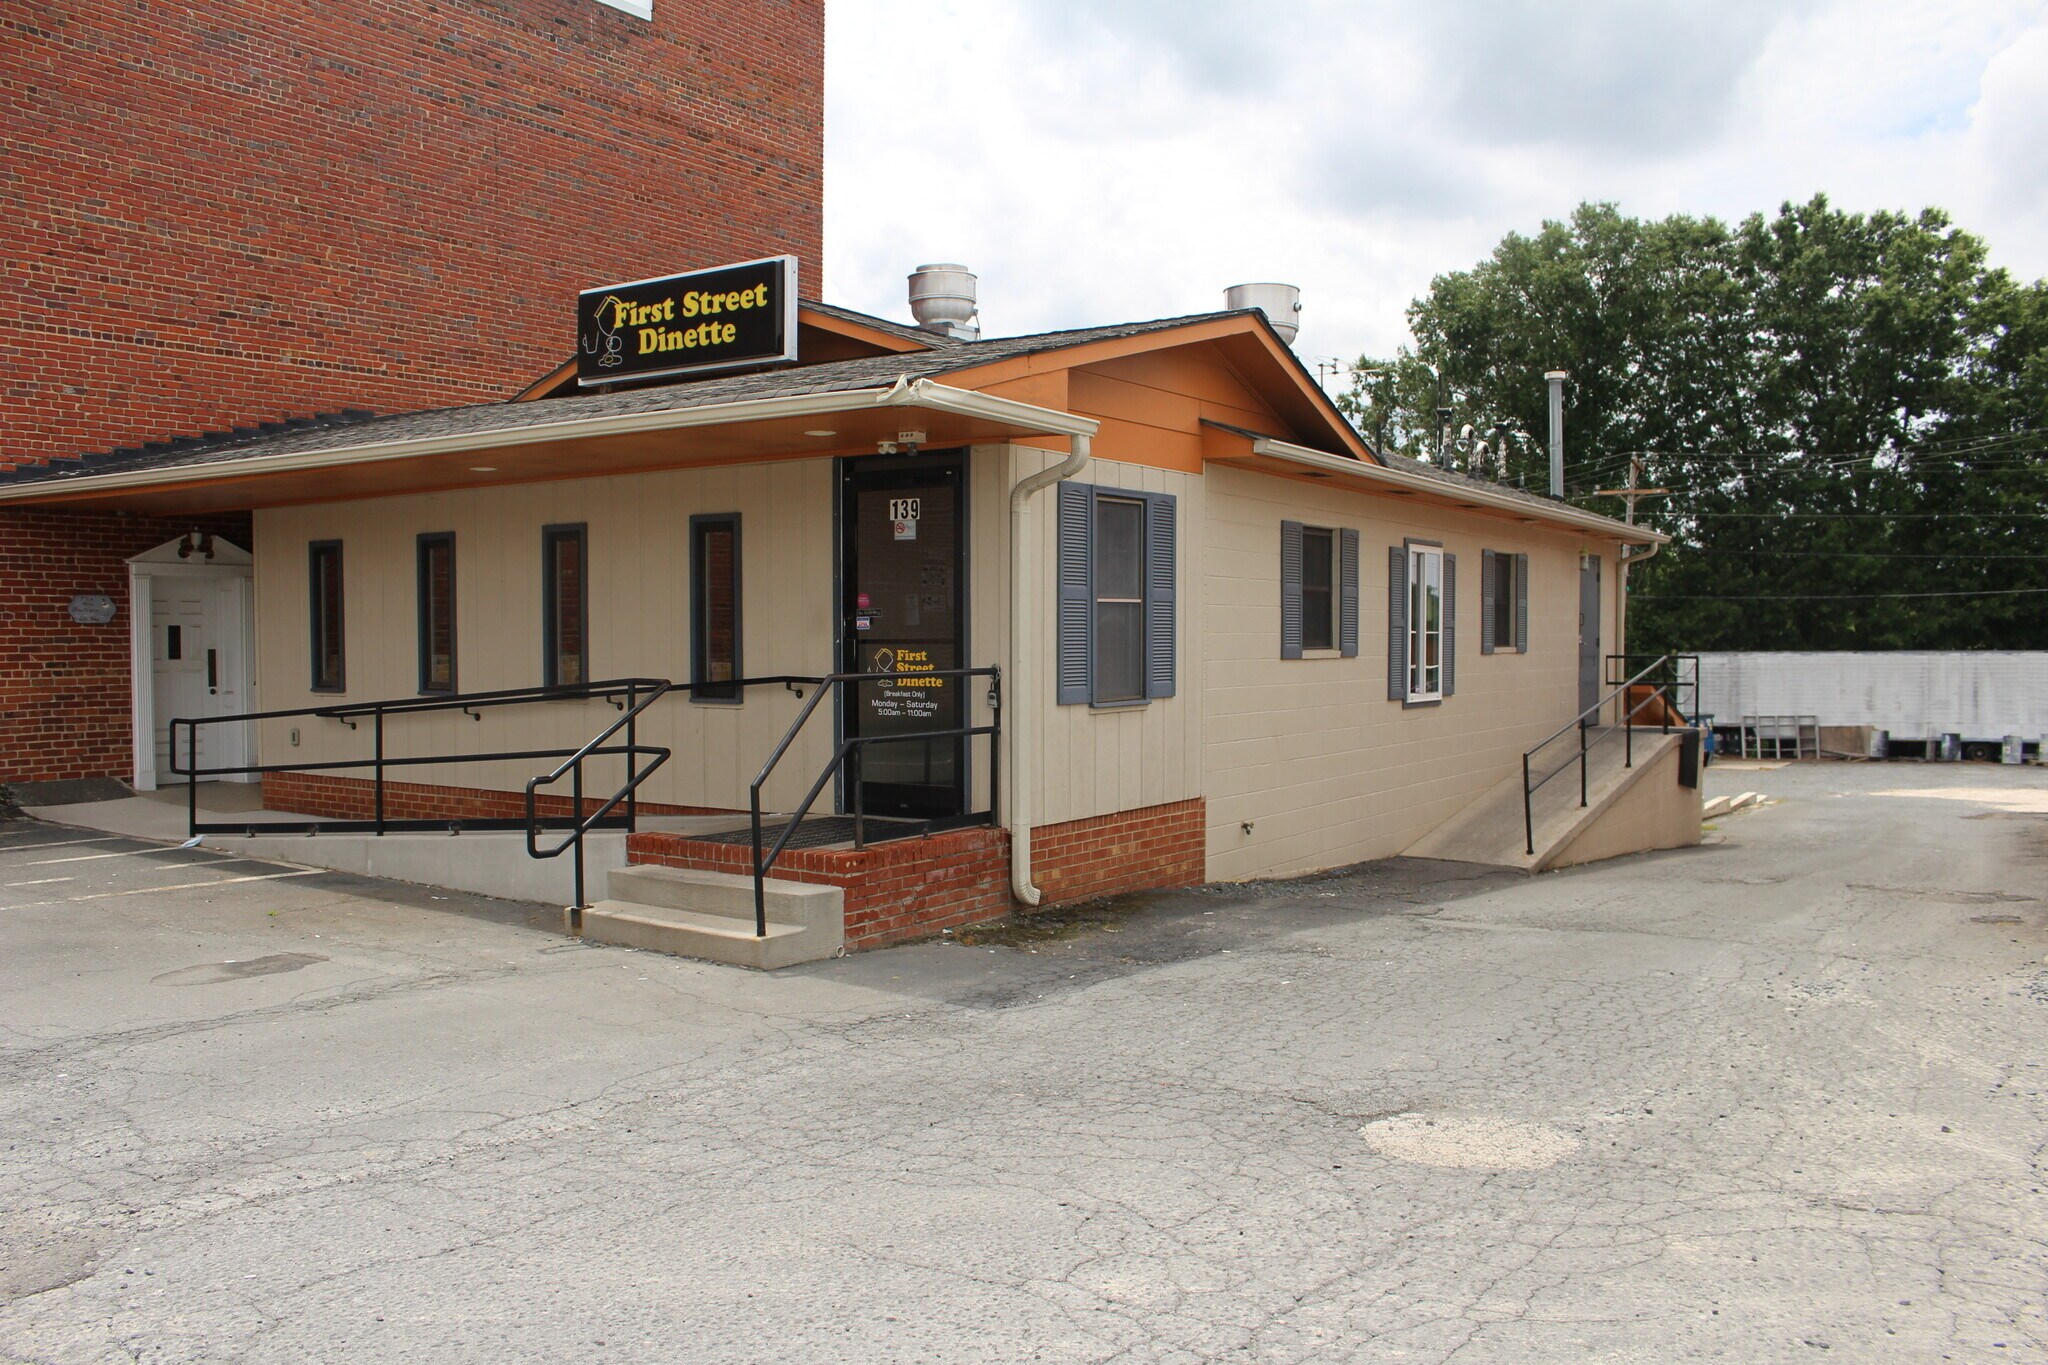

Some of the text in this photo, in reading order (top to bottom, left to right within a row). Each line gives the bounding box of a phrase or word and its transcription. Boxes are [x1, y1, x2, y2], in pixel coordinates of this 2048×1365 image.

[613, 282, 768, 329] First Street
[638, 320, 736, 355] Dinette
[892, 499, 919, 520] 139
[897, 649, 927, 661] First
[911, 691, 926, 699] Only)
[871, 699, 898, 709] Monday
[906, 700, 938, 710] Saturday
[878, 708, 901, 716] 5:00am
[907, 709, 932, 717] 11:00am
